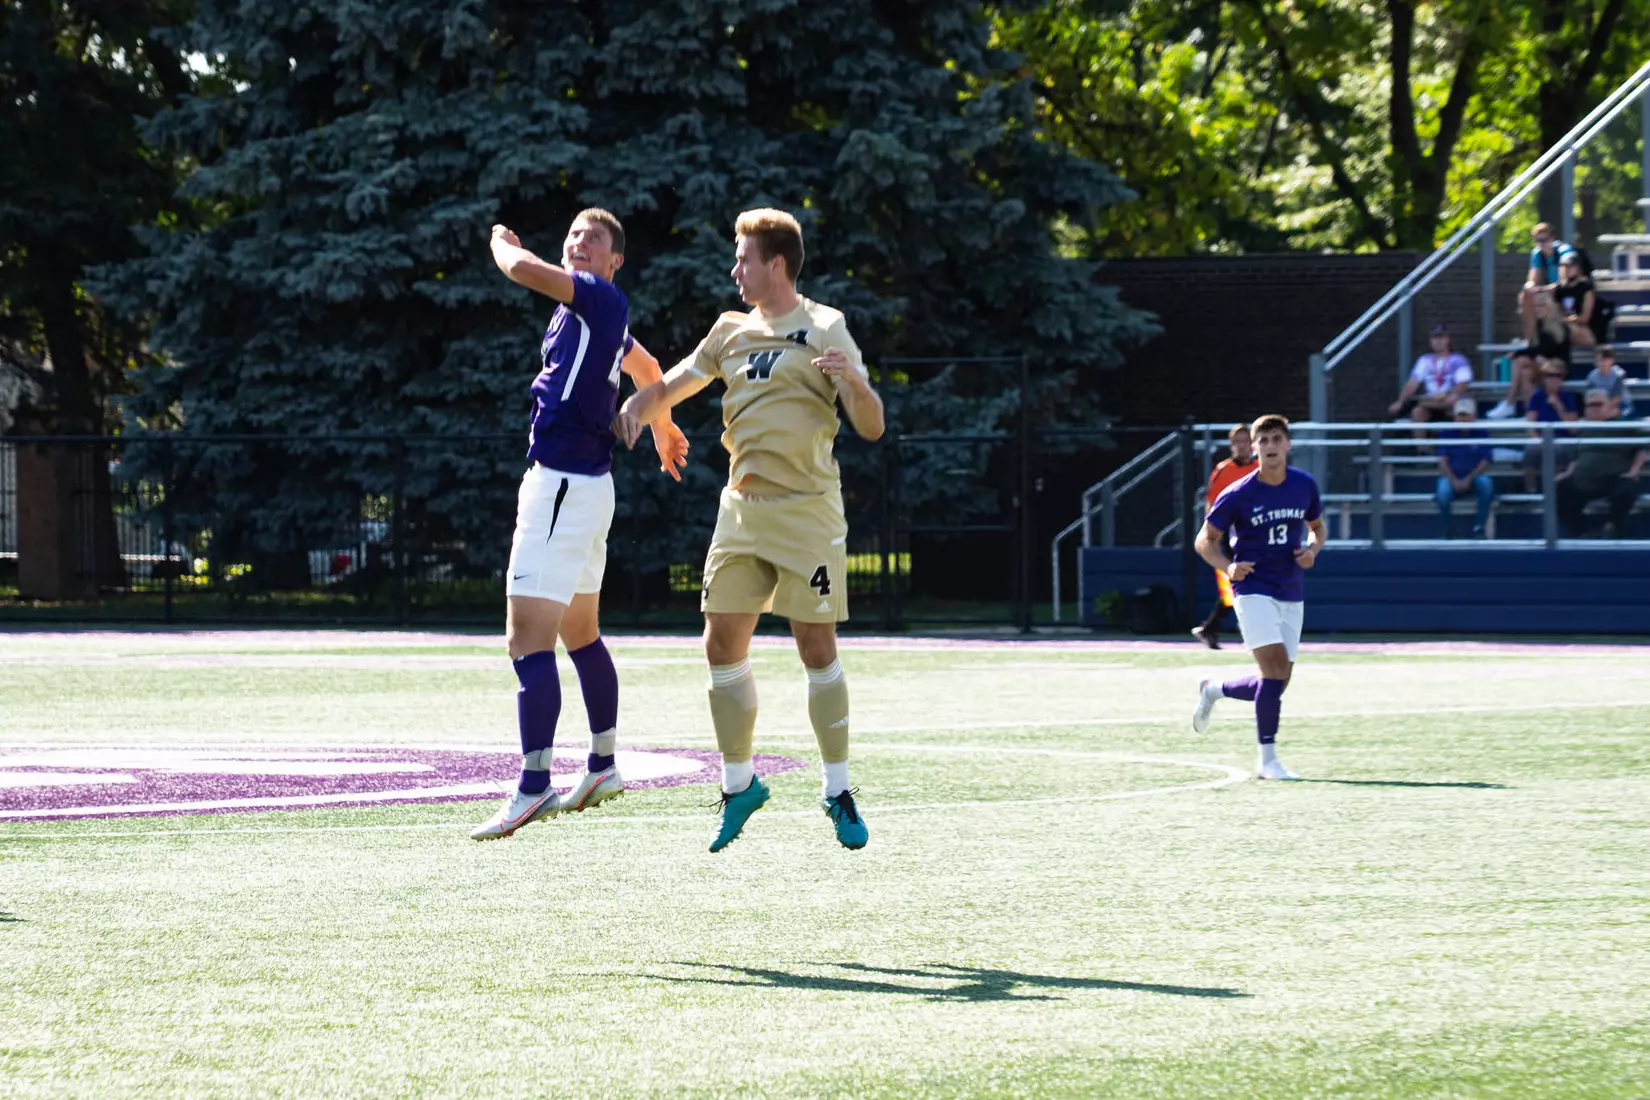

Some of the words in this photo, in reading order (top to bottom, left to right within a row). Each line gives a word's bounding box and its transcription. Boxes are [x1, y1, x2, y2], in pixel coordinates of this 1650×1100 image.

[745, 348, 787, 383] W
[1251, 514, 1268, 526] ST.
[1268, 508, 1305, 520] THOMAS
[1268, 524, 1288, 545] 13
[809, 563, 832, 598] 4
